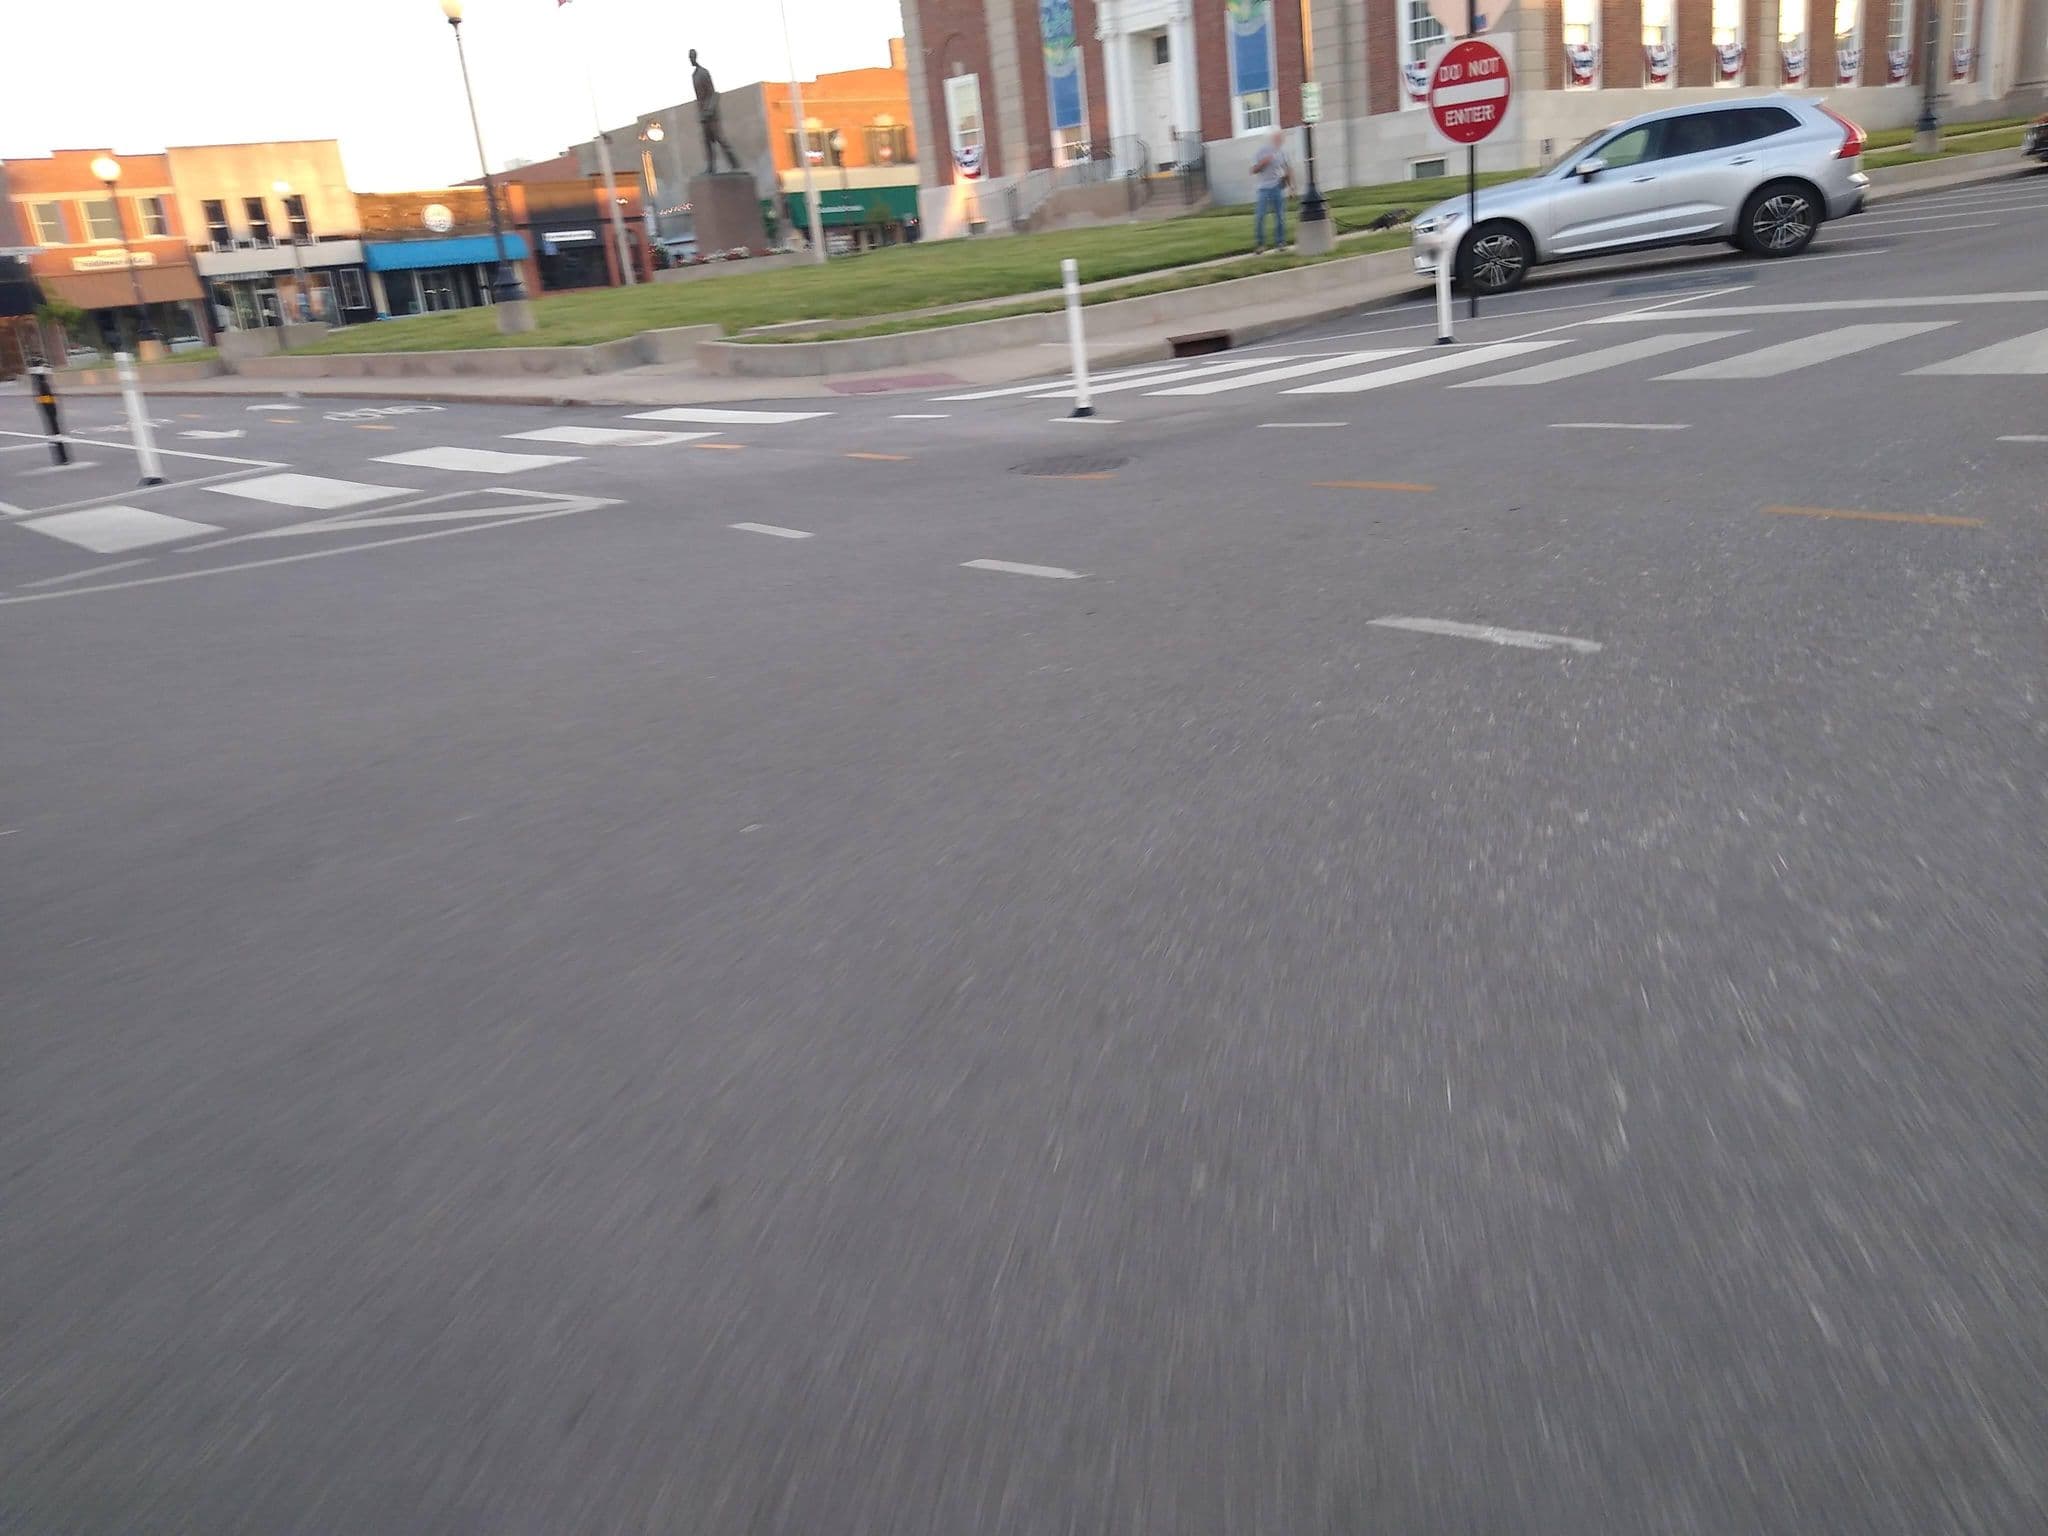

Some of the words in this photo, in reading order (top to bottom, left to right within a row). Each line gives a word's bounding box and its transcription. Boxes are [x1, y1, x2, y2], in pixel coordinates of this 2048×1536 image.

[1440, 64, 1463, 82] DO
[1468, 56, 1501, 77] NOT
[1445, 104, 1495, 127] ENTER
